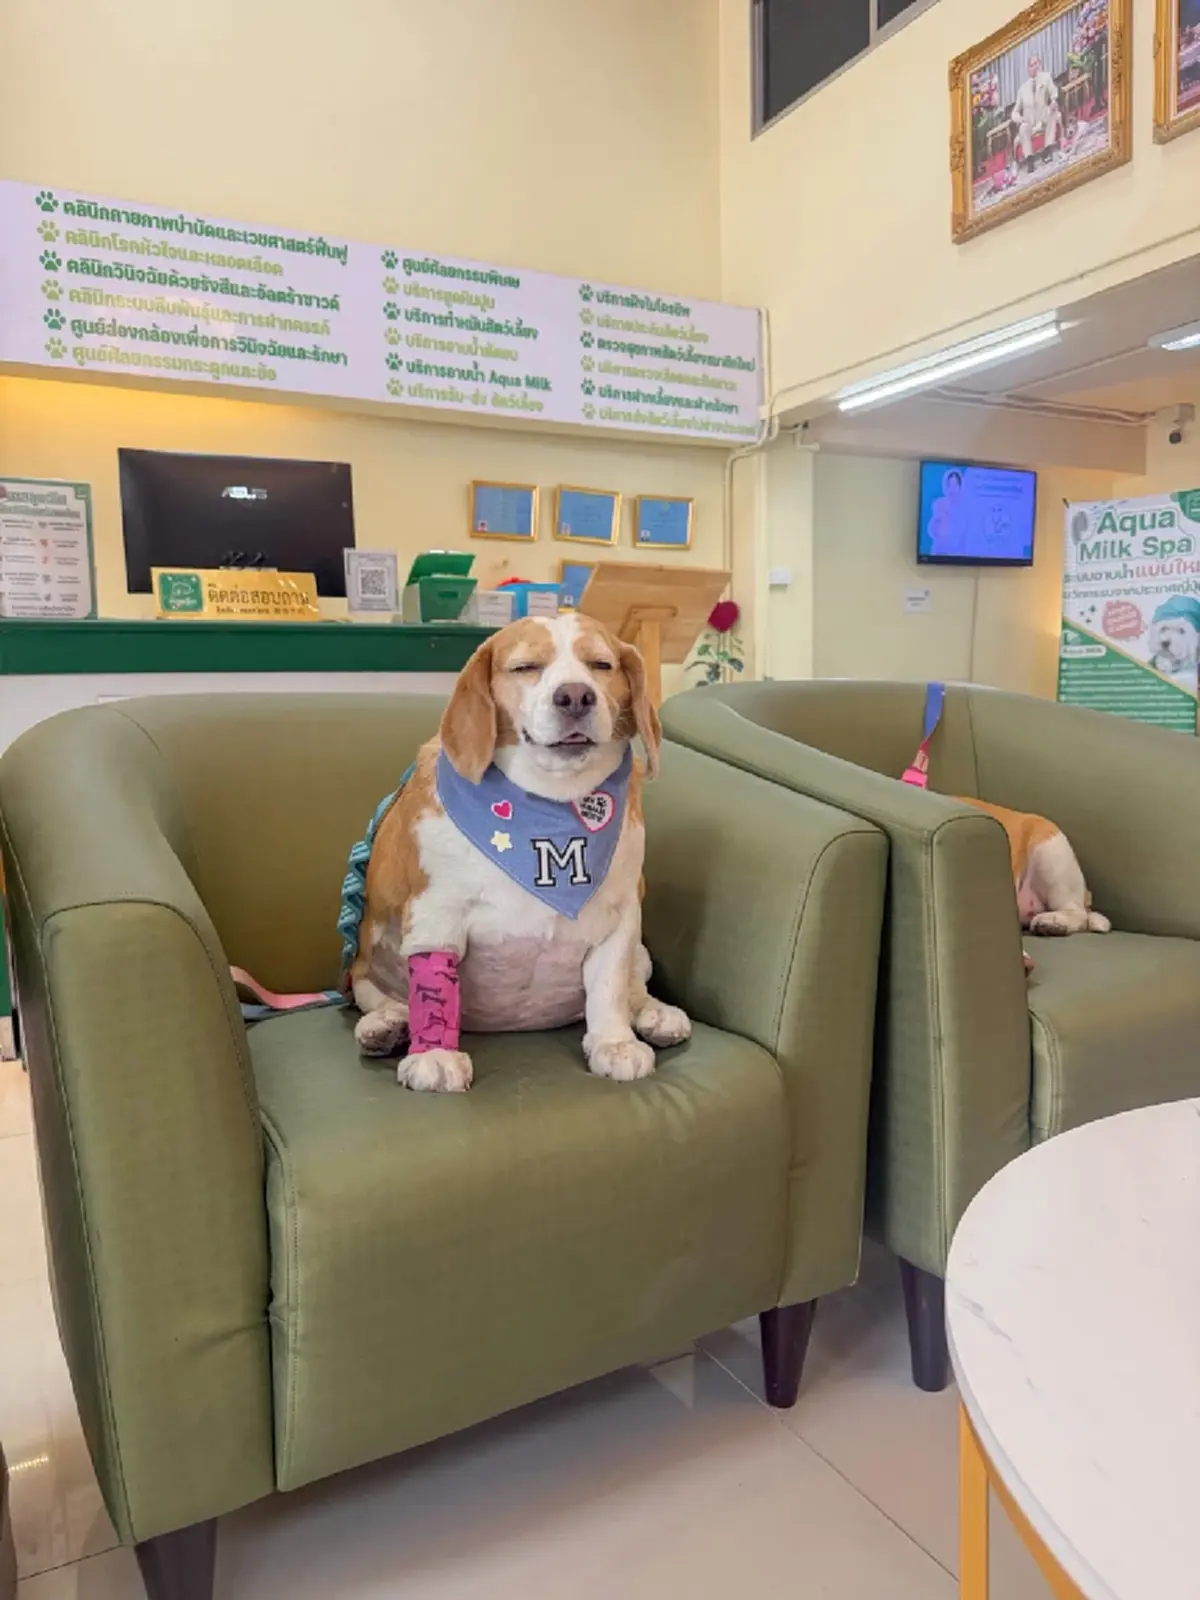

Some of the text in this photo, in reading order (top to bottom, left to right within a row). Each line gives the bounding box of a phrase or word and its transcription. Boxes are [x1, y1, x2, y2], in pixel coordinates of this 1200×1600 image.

[65, 227, 284, 277] คลินิกโรคหัวใจและหลอดเลือด
[70, 314, 348, 368] ศูนย์ส่องกล้องเพื่อการวินิจฉัยและรักษา
[72, 341, 278, 382] ศูนย์ศัลยกรรมกระดูกและข้อ
[406, 359, 552, 391] บริการอาบน้ำ Aqua Milk
[1096, 508, 1176, 537] Aqua
[1079, 535, 1193, 562] Milk Spa
[530, 836, 591, 888] M
